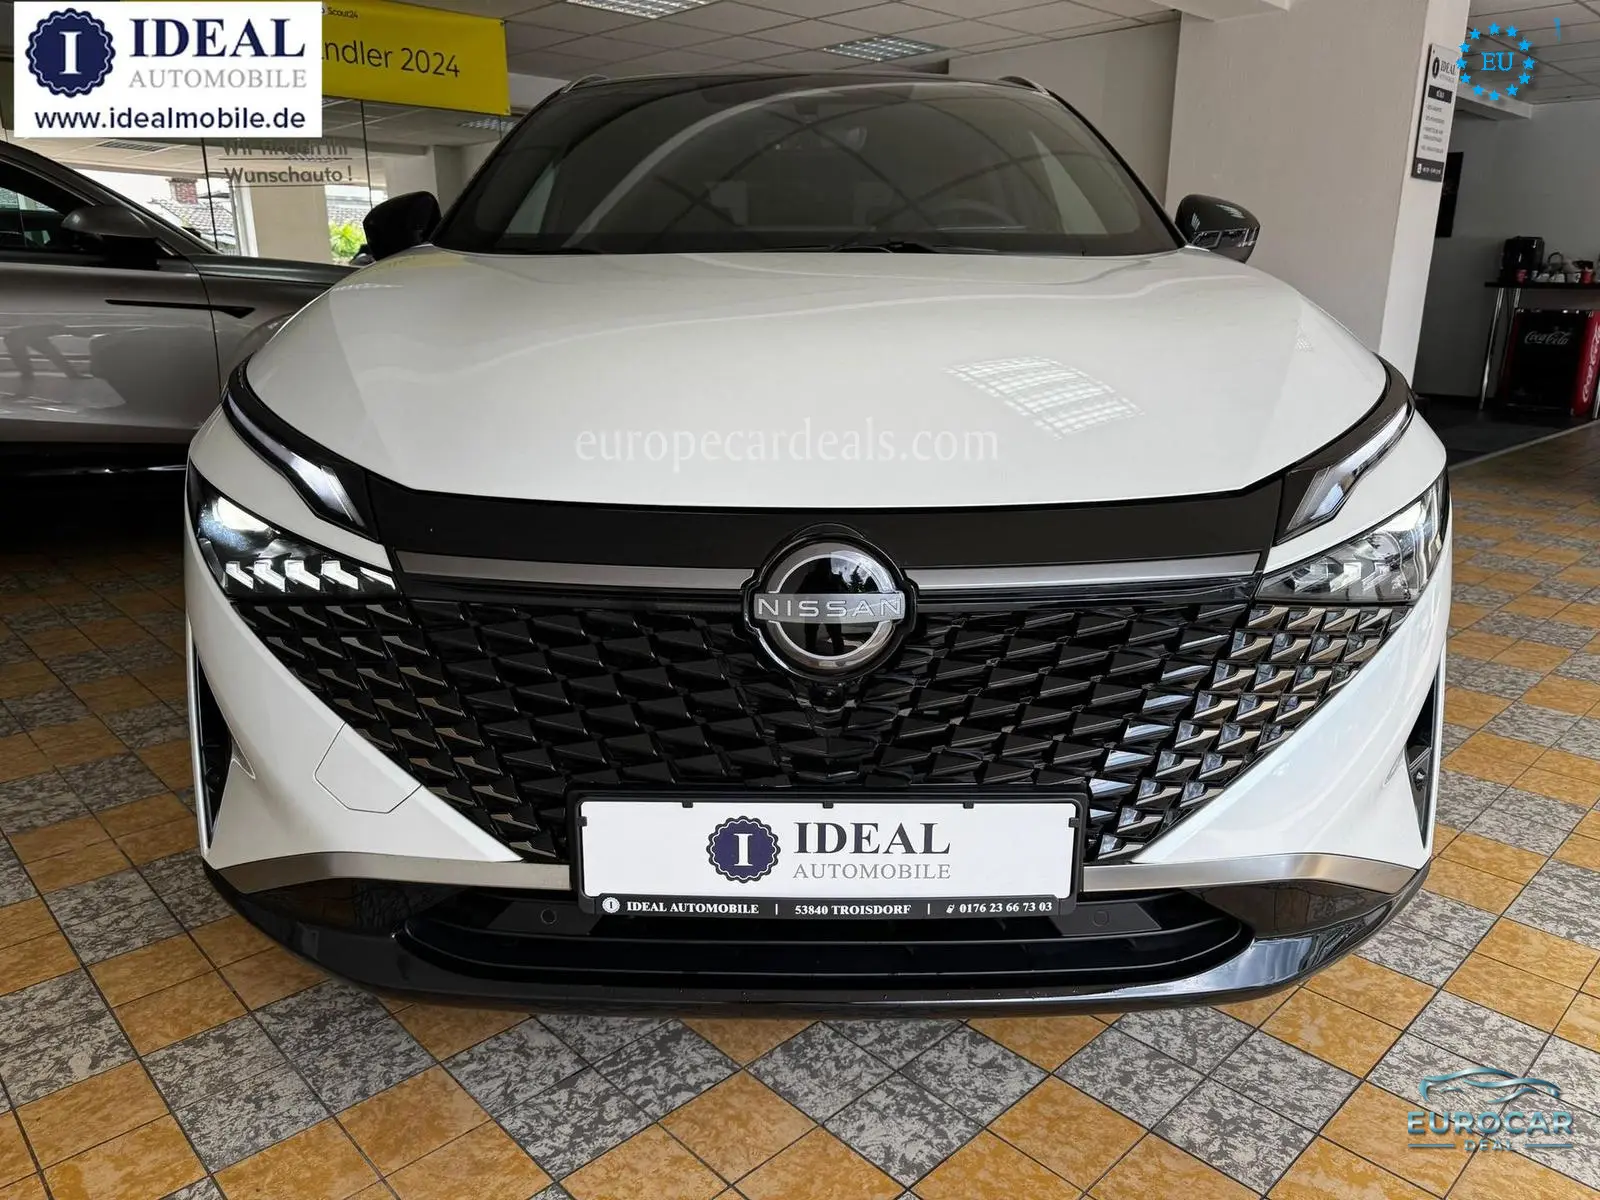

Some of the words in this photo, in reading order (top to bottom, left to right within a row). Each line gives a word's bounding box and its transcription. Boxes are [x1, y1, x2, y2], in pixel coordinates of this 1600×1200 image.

[400, 47, 460, 78] 2024
[224, 166, 343, 184] Wunschauto
[758, 598, 901, 617] NISSAN
[793, 822, 951, 855] IDEAL
[793, 863, 951, 880] AUTOMOBILE
[626, 901, 667, 913] IDEAL
[669, 903, 760, 914] AUTOMOBILE
[794, 904, 828, 915] 53840
[831, 904, 912, 915] TROISDORF
[959, 903, 987, 914] 0176
[989, 903, 1003, 913] 23
[1005, 902, 1020, 912] 66
[1022, 902, 1036, 912] 73
[1038, 901, 1053, 912] 03
